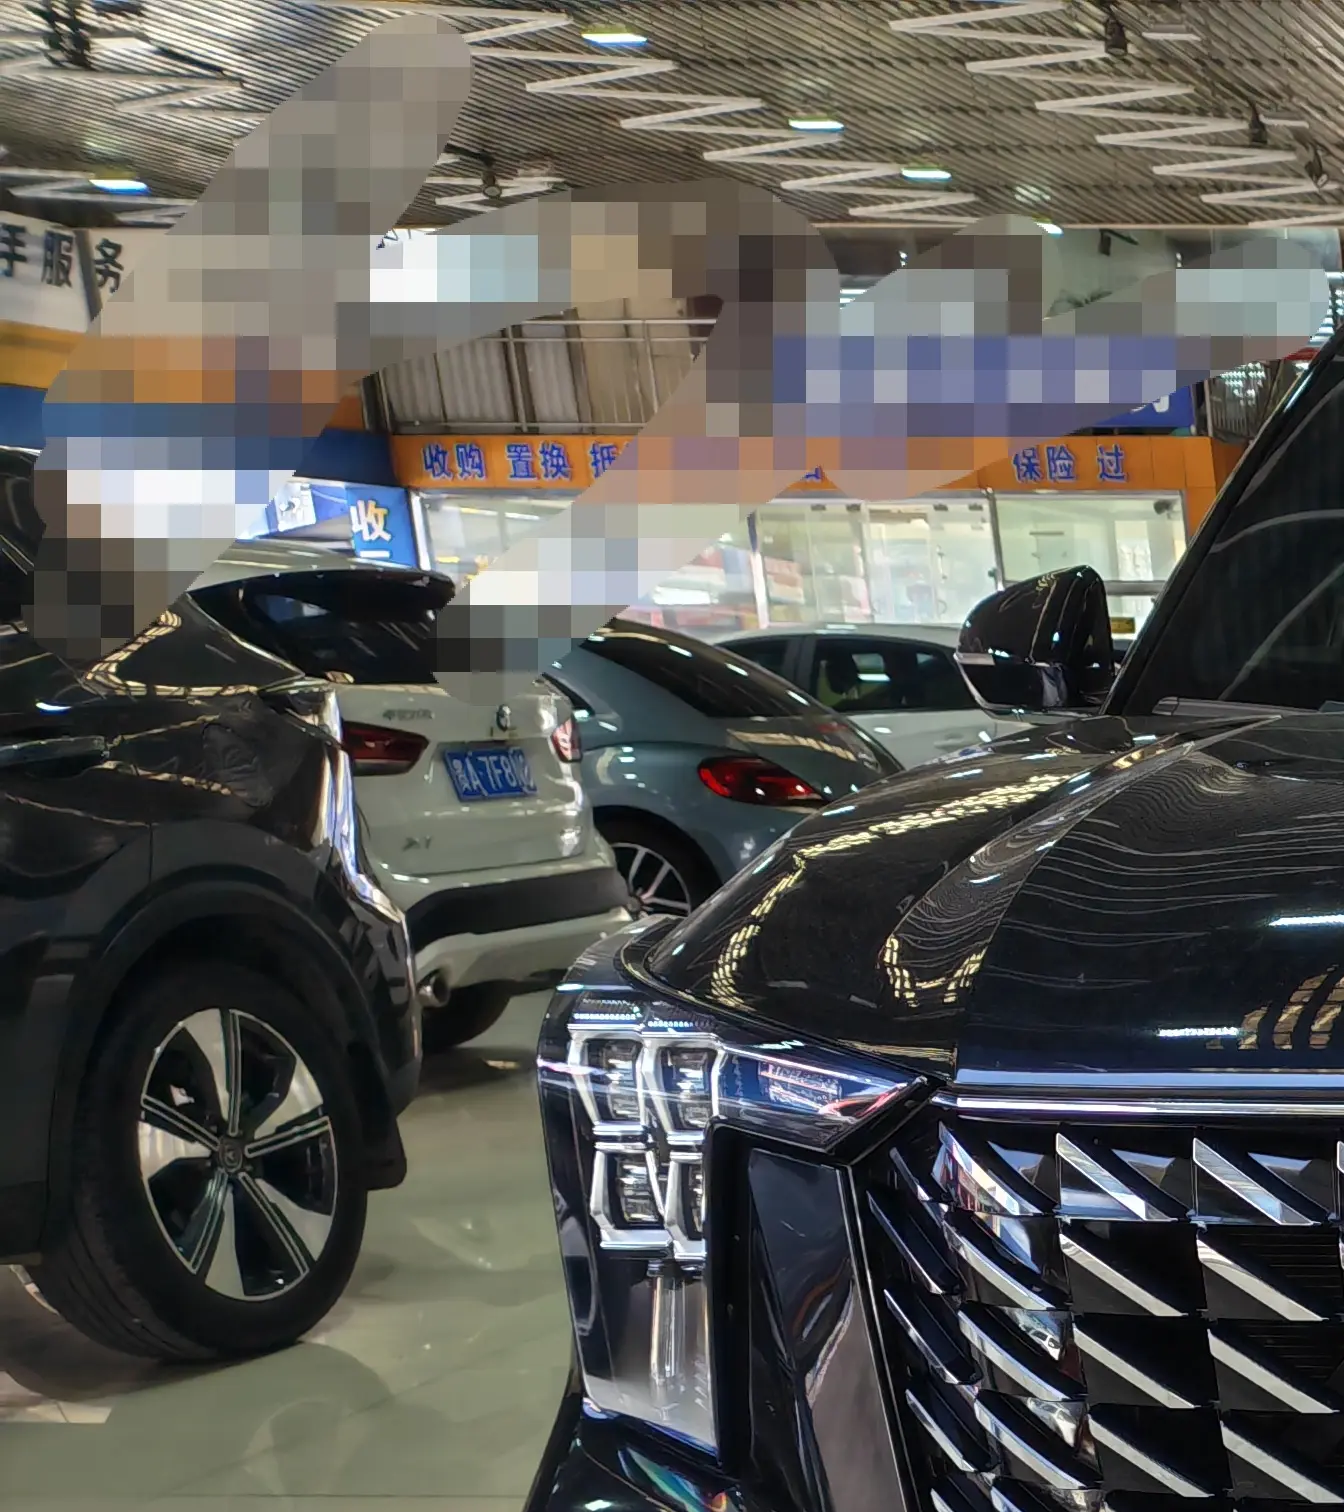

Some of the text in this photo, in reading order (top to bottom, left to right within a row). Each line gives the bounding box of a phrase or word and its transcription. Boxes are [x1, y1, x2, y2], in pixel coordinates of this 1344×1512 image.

[421, 441, 488, 480] 收购
[506, 440, 572, 480] 置换
[1012, 444, 1126, 482] 保险 过
